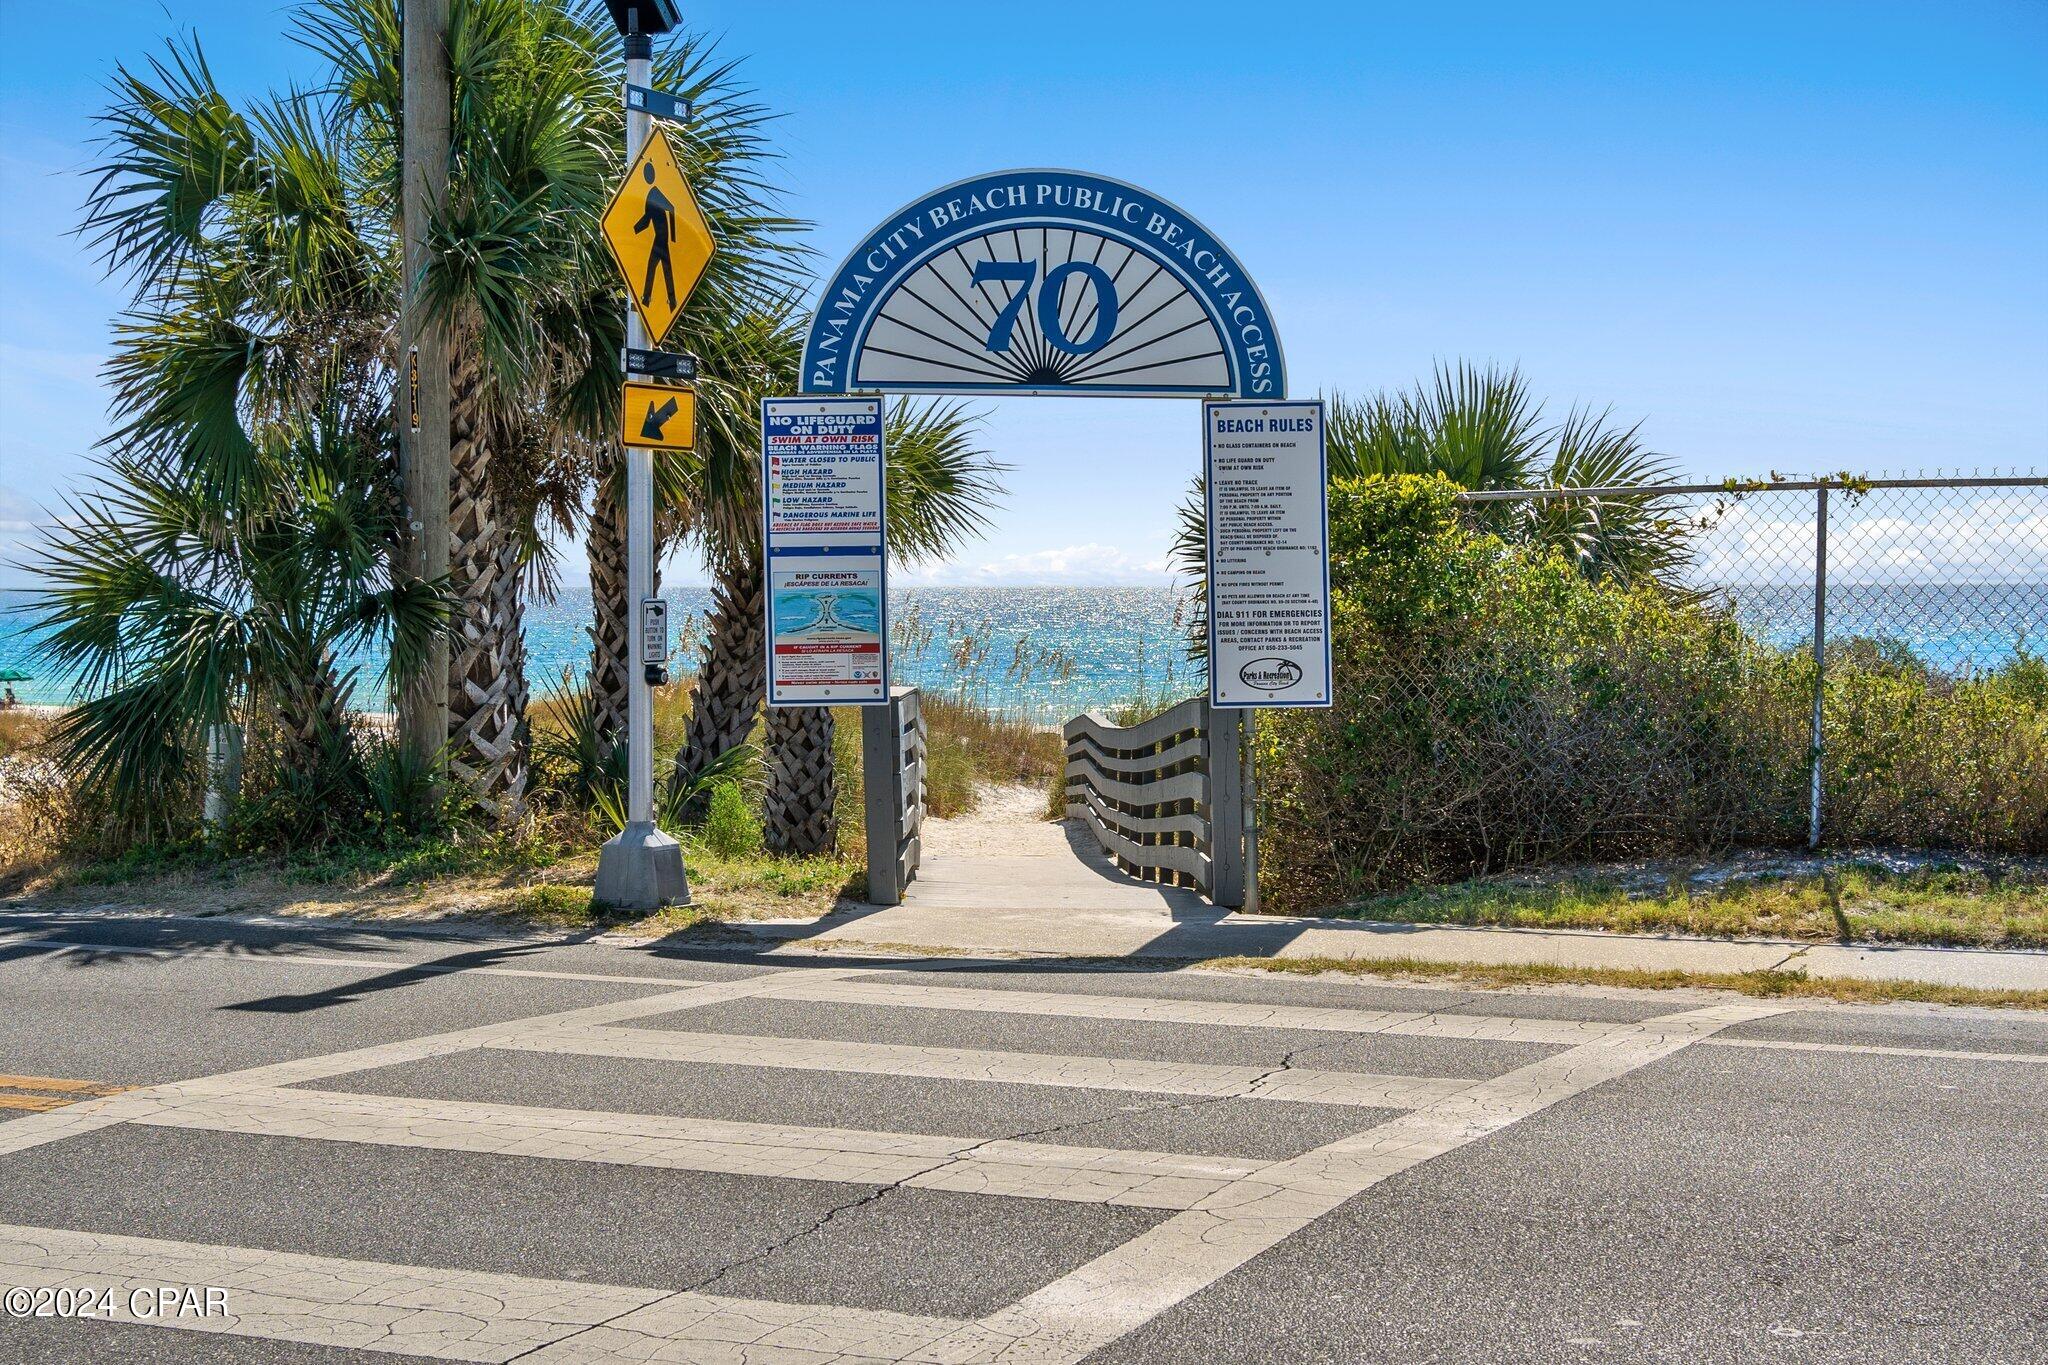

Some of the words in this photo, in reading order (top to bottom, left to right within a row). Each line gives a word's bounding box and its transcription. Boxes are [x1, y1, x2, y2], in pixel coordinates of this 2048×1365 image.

[812, 273, 872, 387] PANAMA
[866, 216, 925, 273] CITY
[929, 185, 1027, 230] BEACH
[1036, 184, 1144, 225] PUBLIC
[1145, 214, 1231, 289] BEACH
[1220, 289, 1273, 394] ACCESS
[970, 258, 1119, 354] 70
[769, 417, 791, 425] NO
[797, 416, 876, 425] LIFEGUARD
[1218, 419, 1263, 432] BEACH
[1270, 419, 1313, 432] RULES
[790, 426, 812, 434] ON
[818, 425, 855, 434] DUTY
[1244, 672, 1257, 680] Parks
[1263, 671, 1290, 679] Recreation
